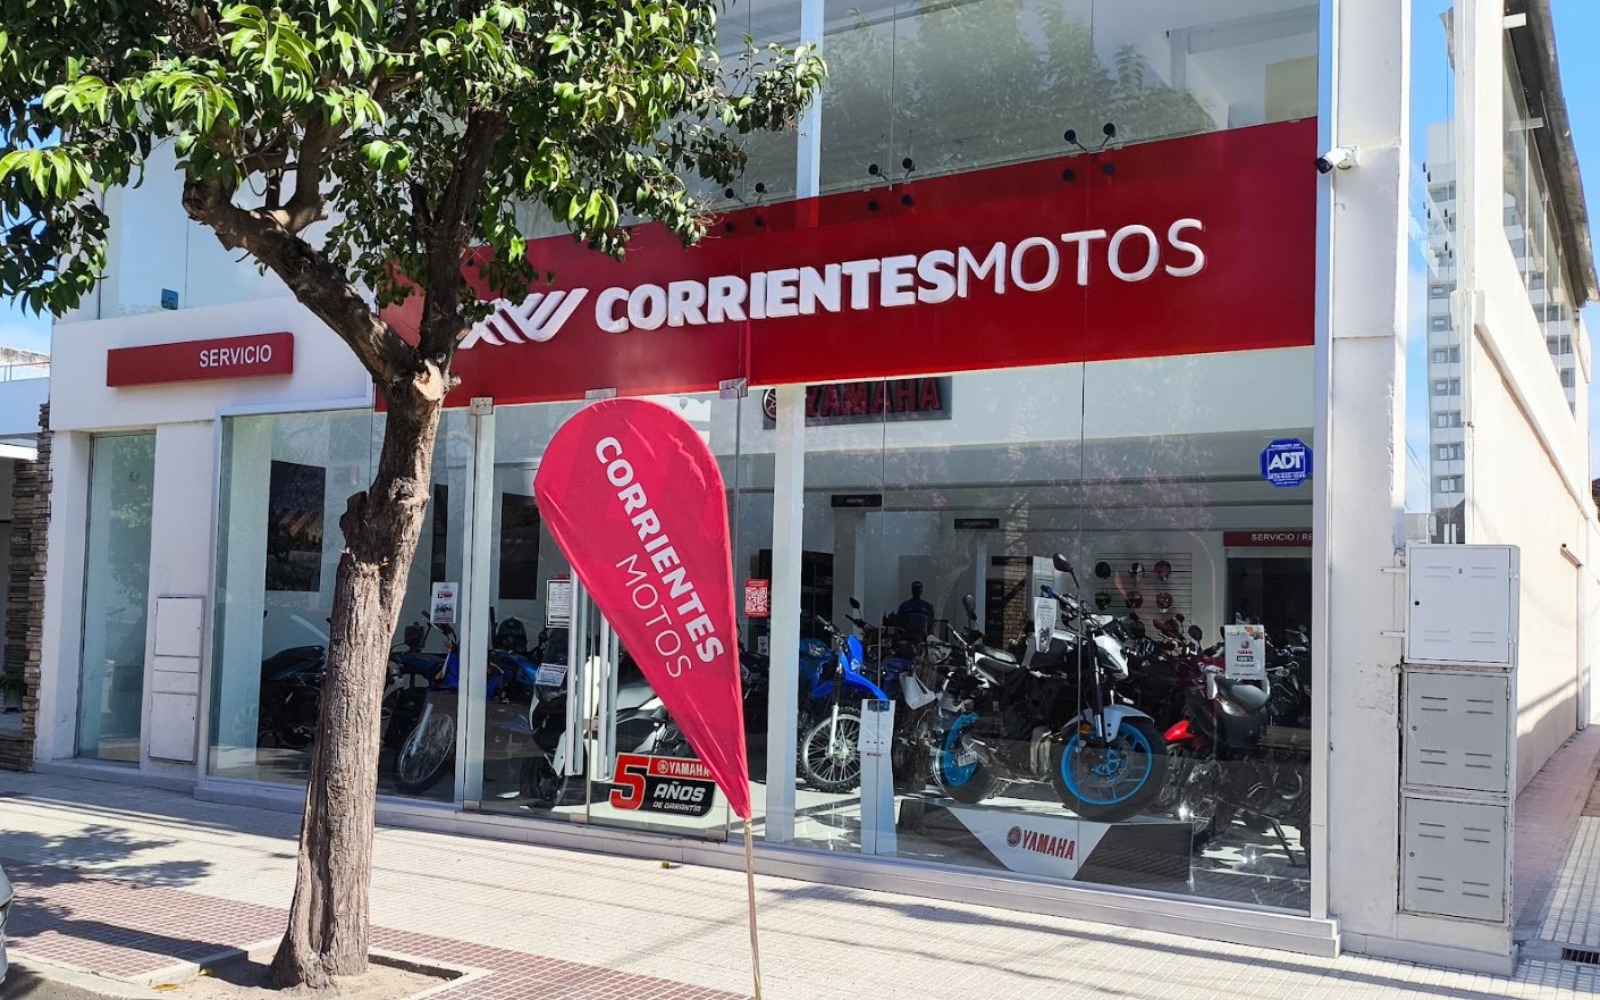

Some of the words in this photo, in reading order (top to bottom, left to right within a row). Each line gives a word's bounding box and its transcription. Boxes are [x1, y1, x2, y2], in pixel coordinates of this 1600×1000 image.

[200, 344, 272, 368] SERVICIO
[1269, 452, 1304, 470] ADT
[1251, 533, 1294, 541] SERVICIO
[595, 436, 724, 663] CORRIENTES
[615, 554, 692, 679] MOTOS
[669, 761, 711, 776] YAMAHA
[609, 752, 650, 811] 5
[653, 781, 706, 802] AÑOS
[1022, 830, 1075, 860] YAMAHA
